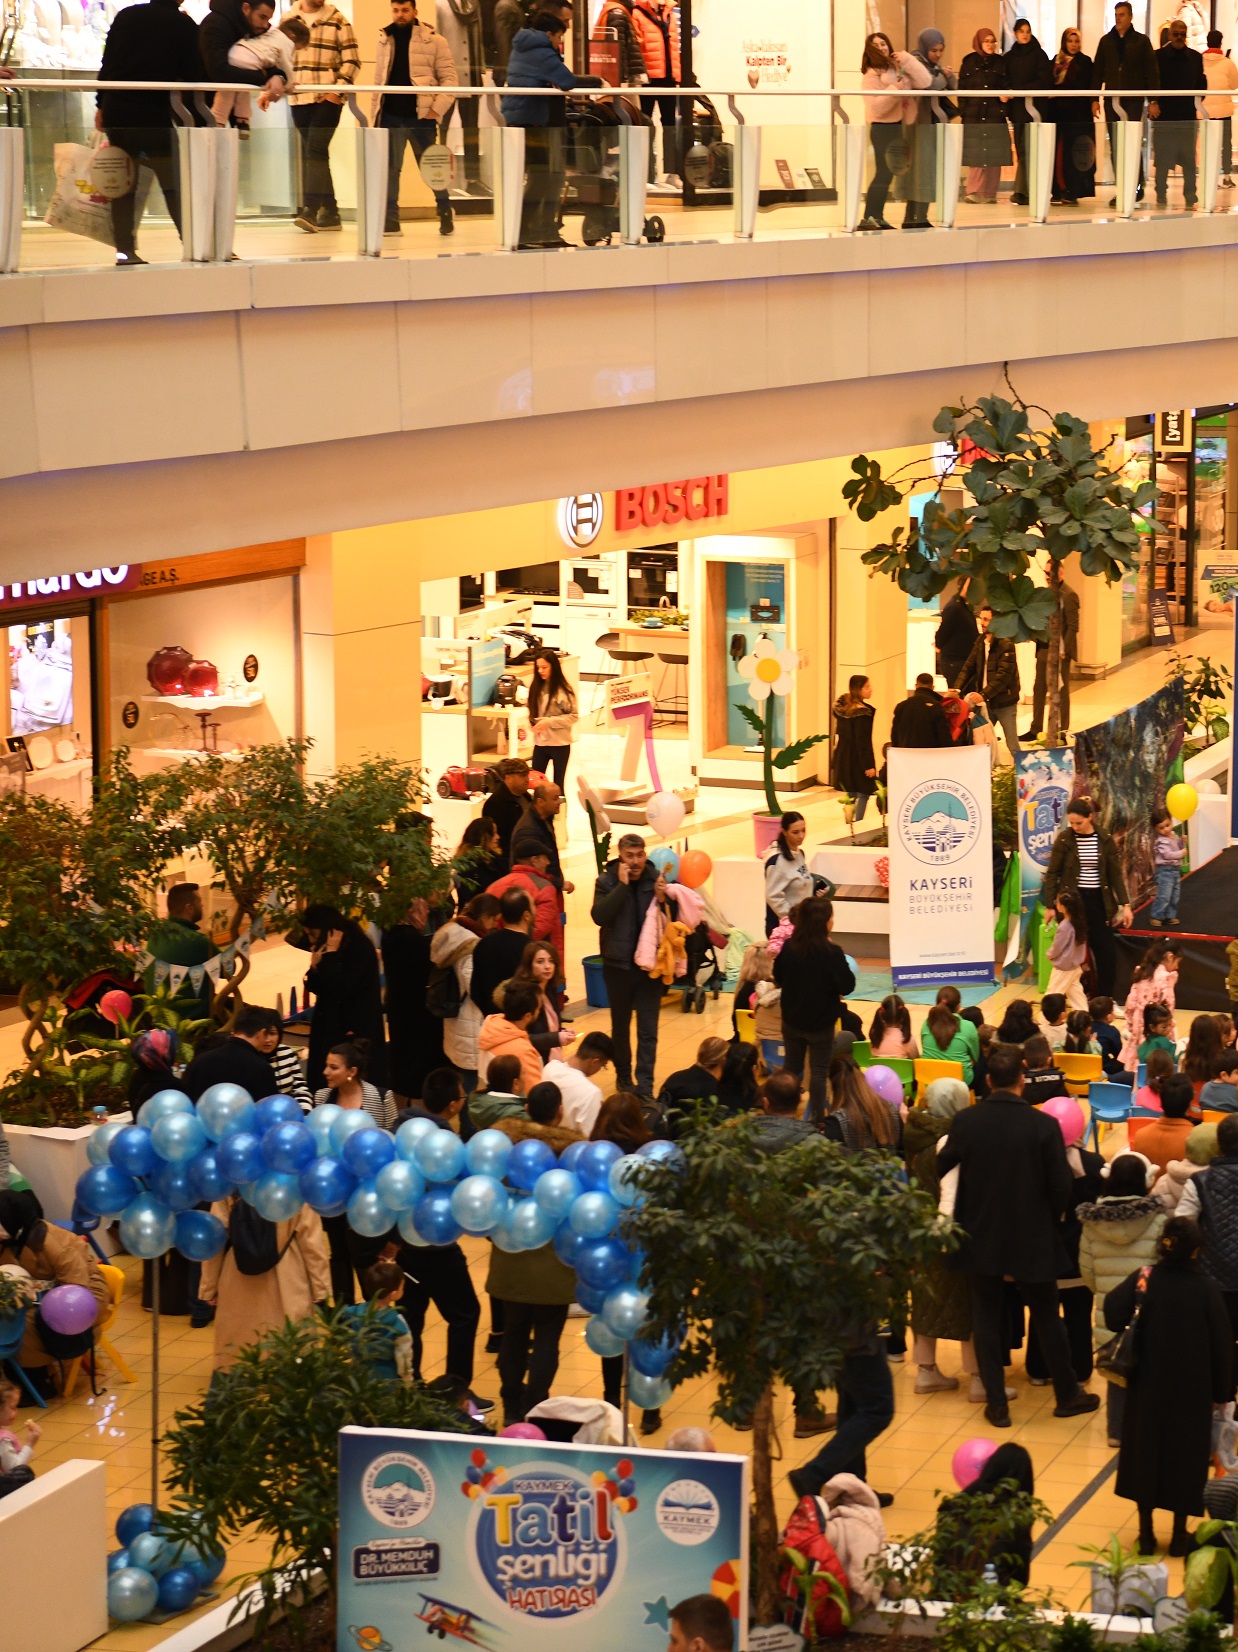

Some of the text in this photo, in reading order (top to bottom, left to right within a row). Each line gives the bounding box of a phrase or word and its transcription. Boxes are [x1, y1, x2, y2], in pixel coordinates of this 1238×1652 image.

[615, 473, 729, 532] BOSCH
[1209, 581, 1229, 594] 120
[909, 876, 973, 892] KAYSERİ
[909, 903, 973, 915] BELEDİYESİ
[513, 1479, 576, 1493] KAYMEK
[485, 1487, 615, 1547] Tatil
[662, 1514, 711, 1524] KAYMEK
[360, 1549, 434, 1565] DR. MEMDUH
[360, 1560, 429, 1576] BÜYÜKKILIÇ
[497, 1543, 608, 1589] şenliği
